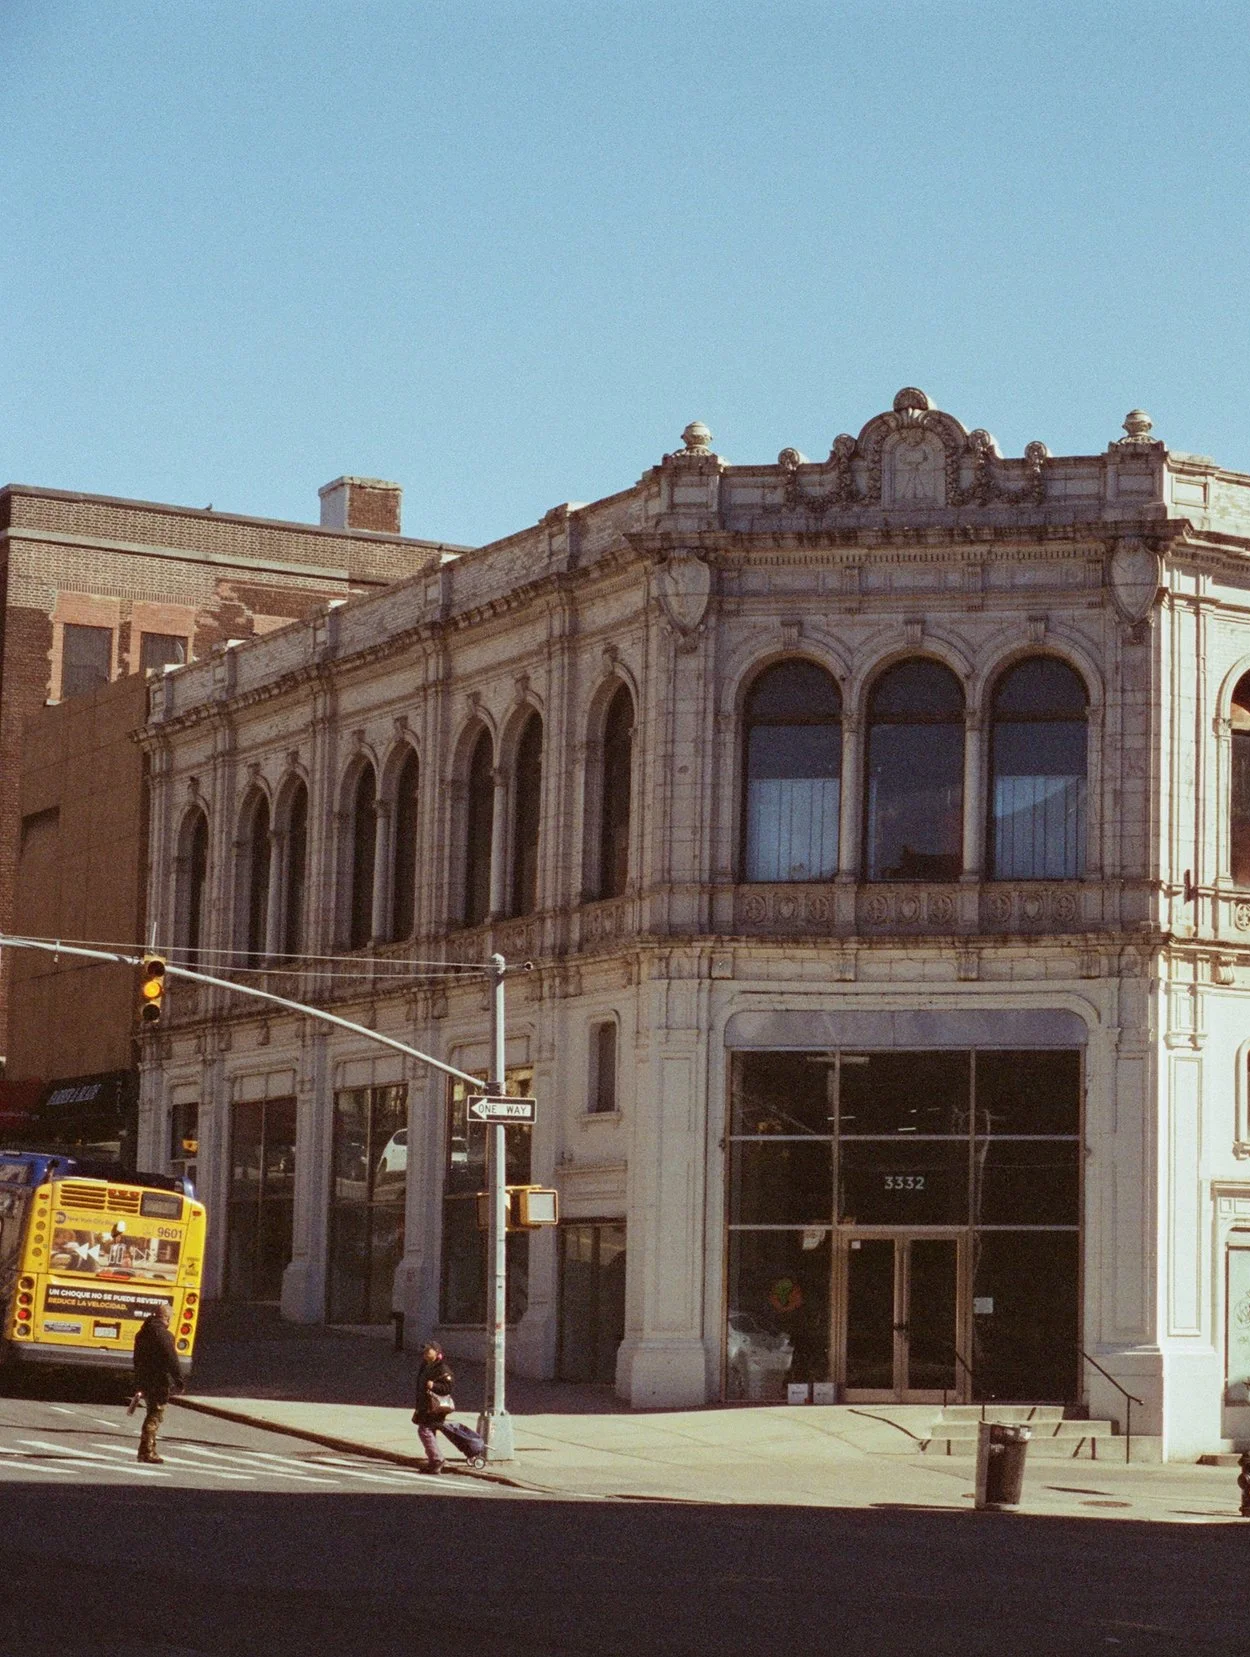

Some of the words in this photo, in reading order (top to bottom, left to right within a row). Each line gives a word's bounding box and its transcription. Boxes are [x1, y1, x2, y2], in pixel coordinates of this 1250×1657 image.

[479, 1104, 497, 1114] ONE
[506, 1105, 526, 1115] WAY
[884, 1176, 925, 1190] 3332
[157, 1227, 182, 1240] 9601
[60, 1290, 91, 1299] CHOQUE
[48, 1297, 76, 1305] REDUCE
